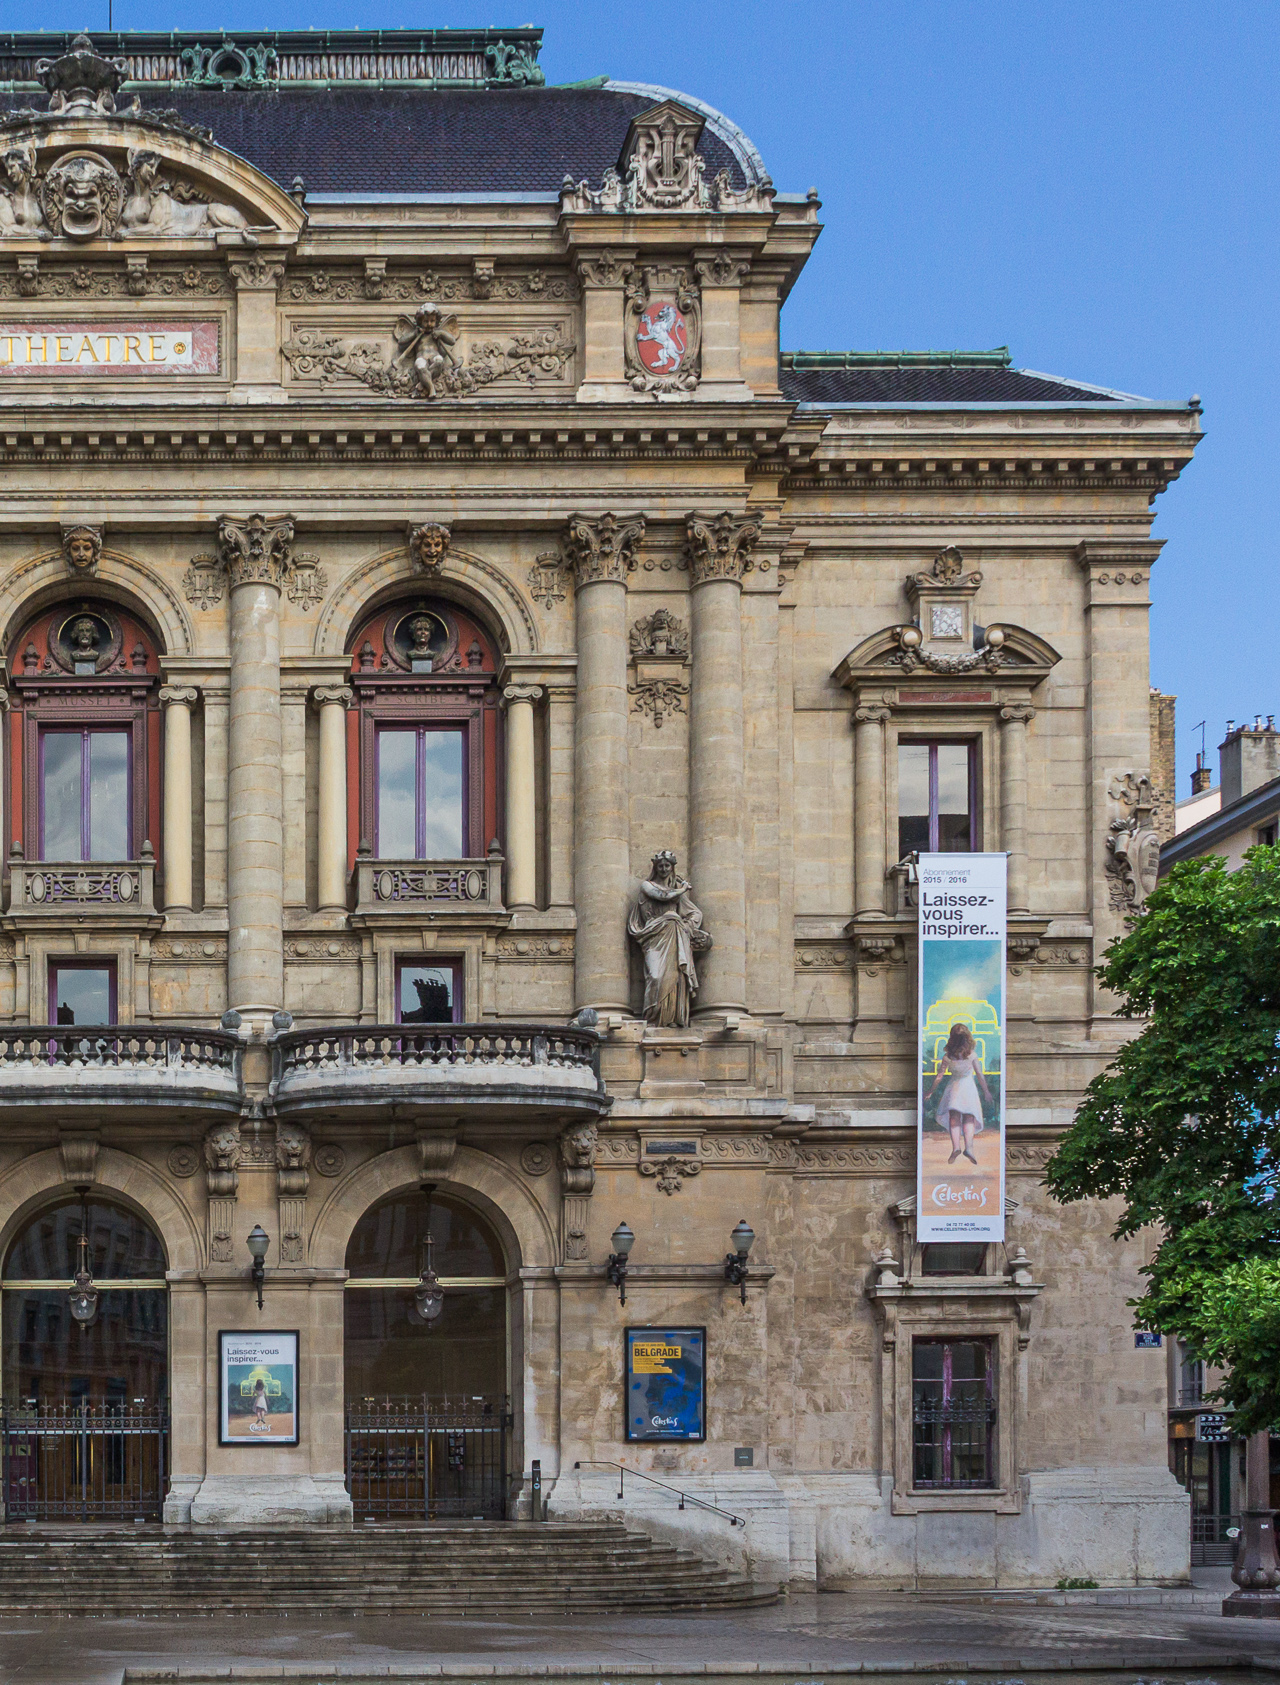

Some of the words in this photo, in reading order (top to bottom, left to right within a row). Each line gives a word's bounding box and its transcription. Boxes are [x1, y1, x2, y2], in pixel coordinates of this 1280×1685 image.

[0, 335, 167, 363] THEATRE
[58, 697, 111, 706] MUSSET
[397, 695, 446, 704] SCRIBE
[923, 868, 971, 876] Abonnement
[923, 892, 994, 907] Laissez-
[922, 910, 963, 920] vous
[923, 921, 999, 938] inspirer...
[932, 1183, 989, 1207] Célestins
[634, 1348, 679, 1357] BELGRADE
[227, 1356, 263, 1364] inspirer...
[652, 1415, 679, 1427] Célestins
